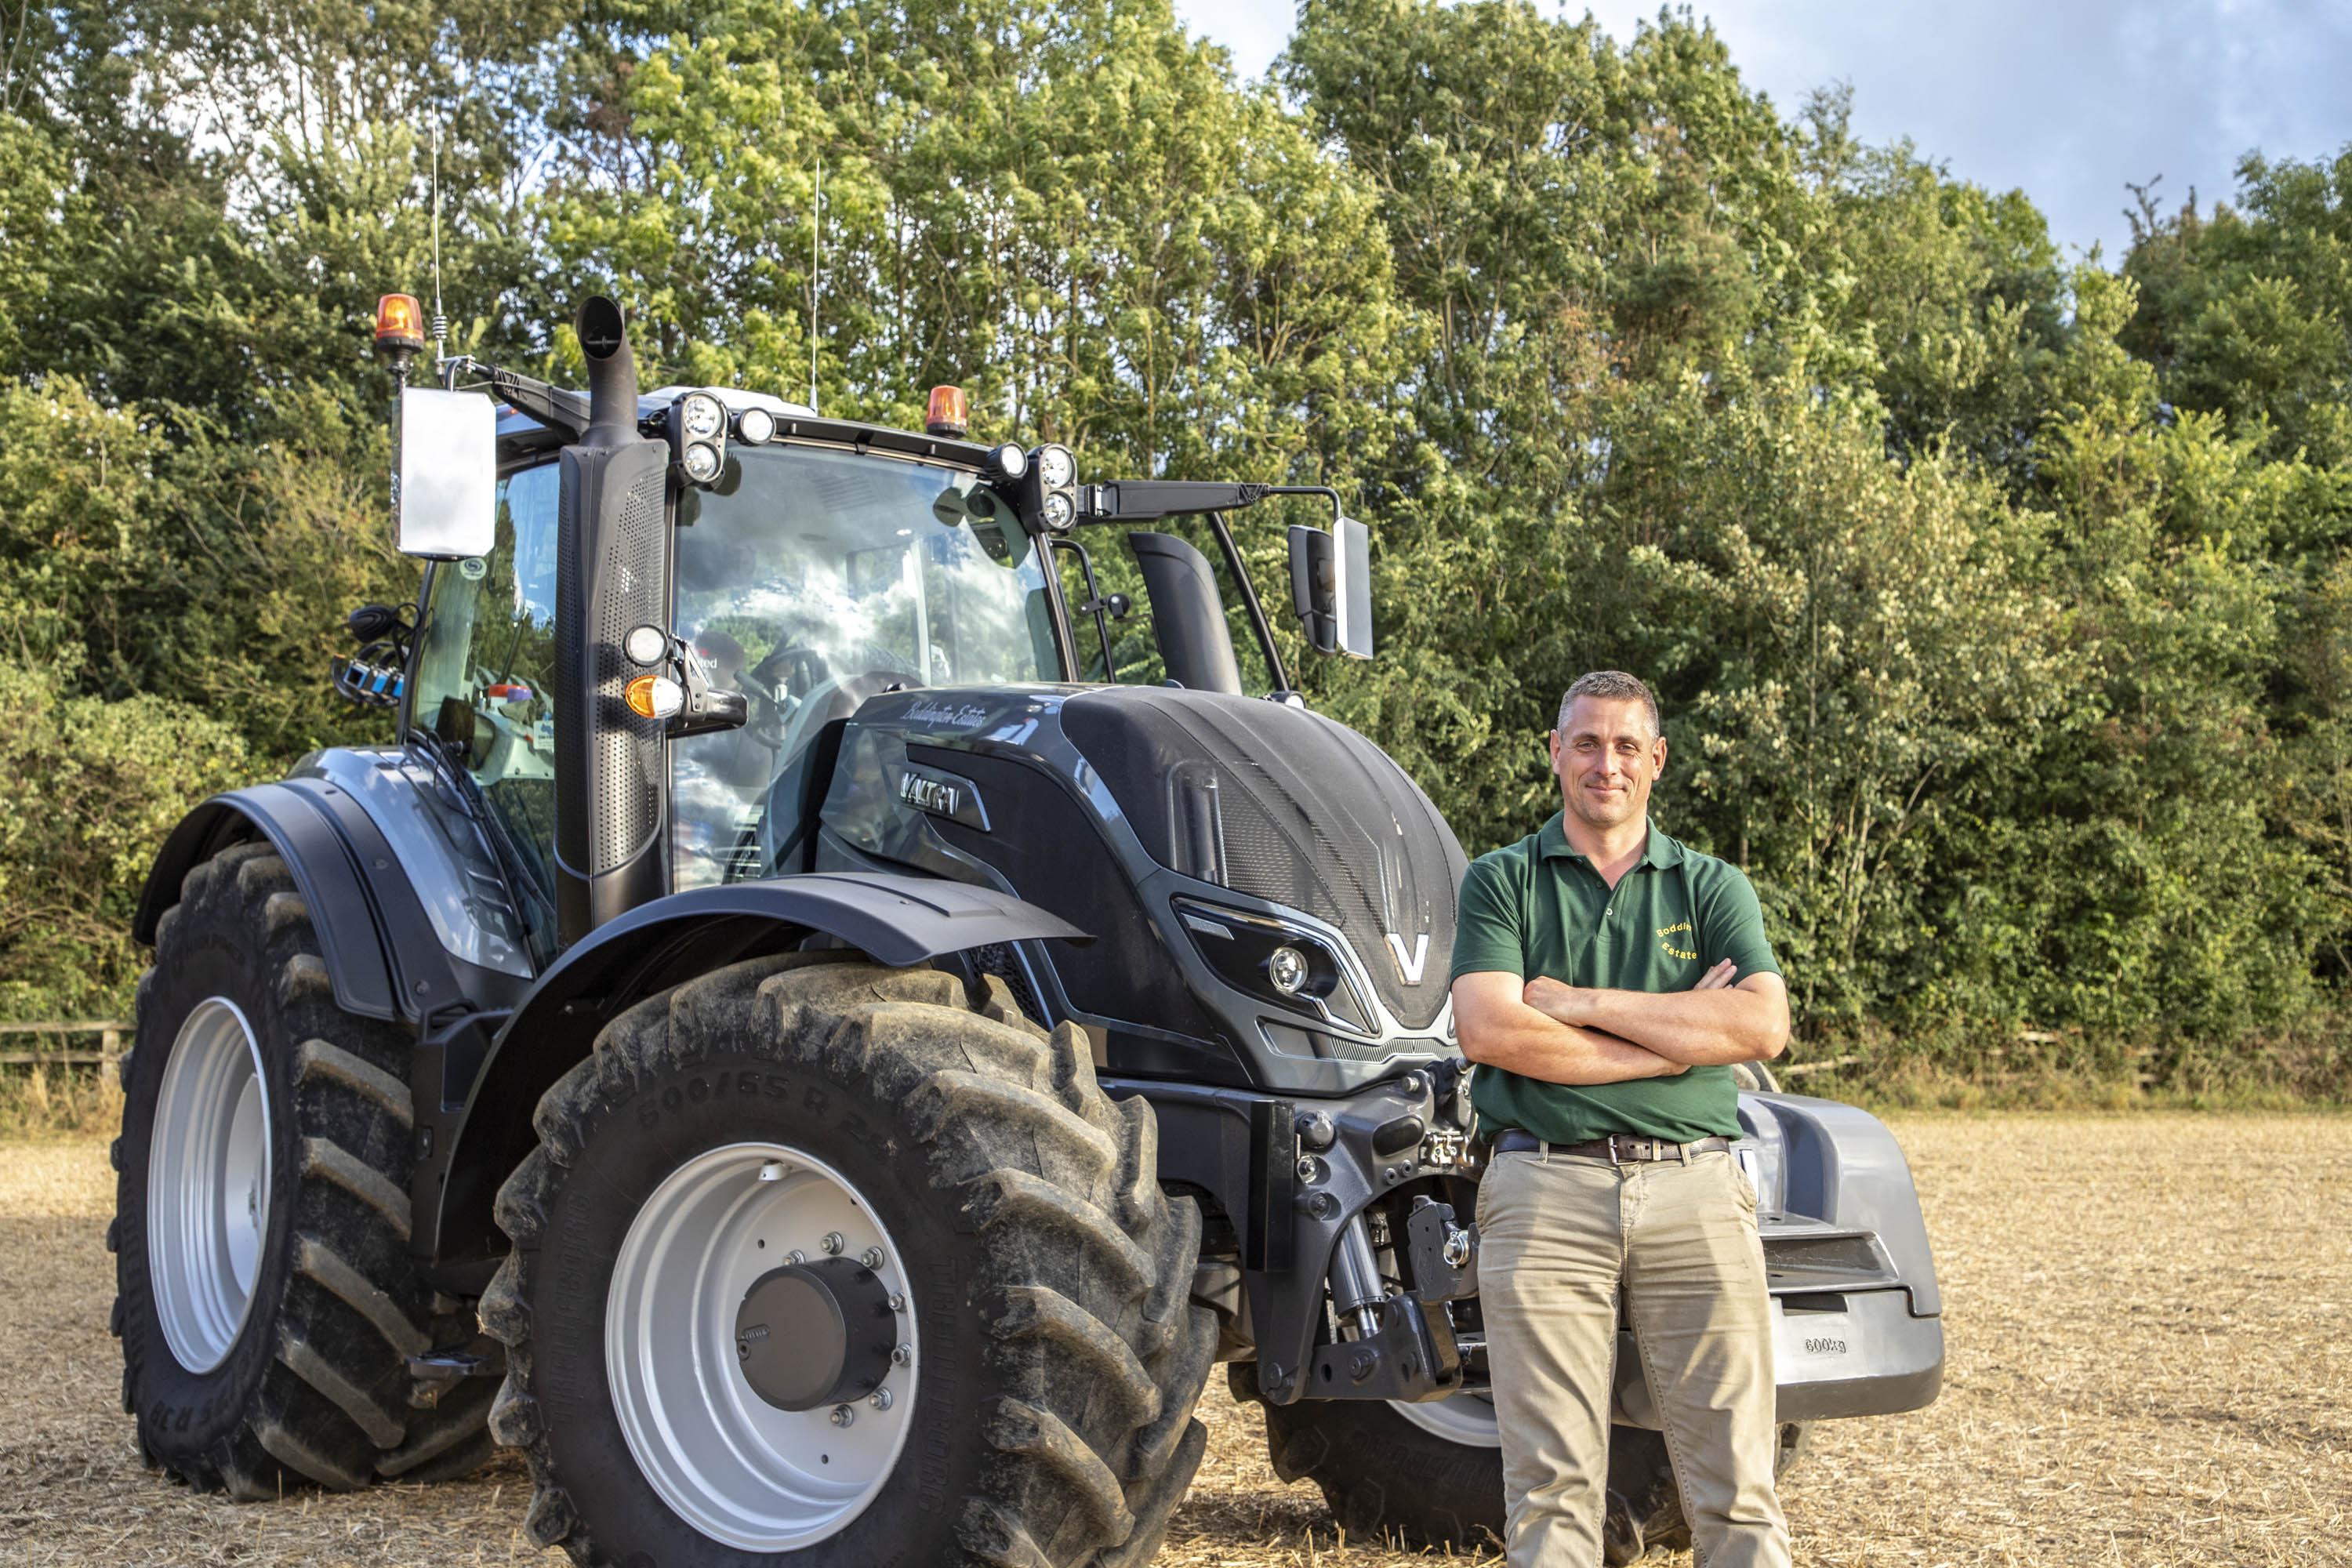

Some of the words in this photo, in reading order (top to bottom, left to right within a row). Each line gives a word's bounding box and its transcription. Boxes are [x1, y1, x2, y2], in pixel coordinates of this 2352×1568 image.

[1655, 922, 1692, 938] Boddin
[1661, 942, 1697, 960] Estate
[1806, 1337, 1846, 1353] 600kg
